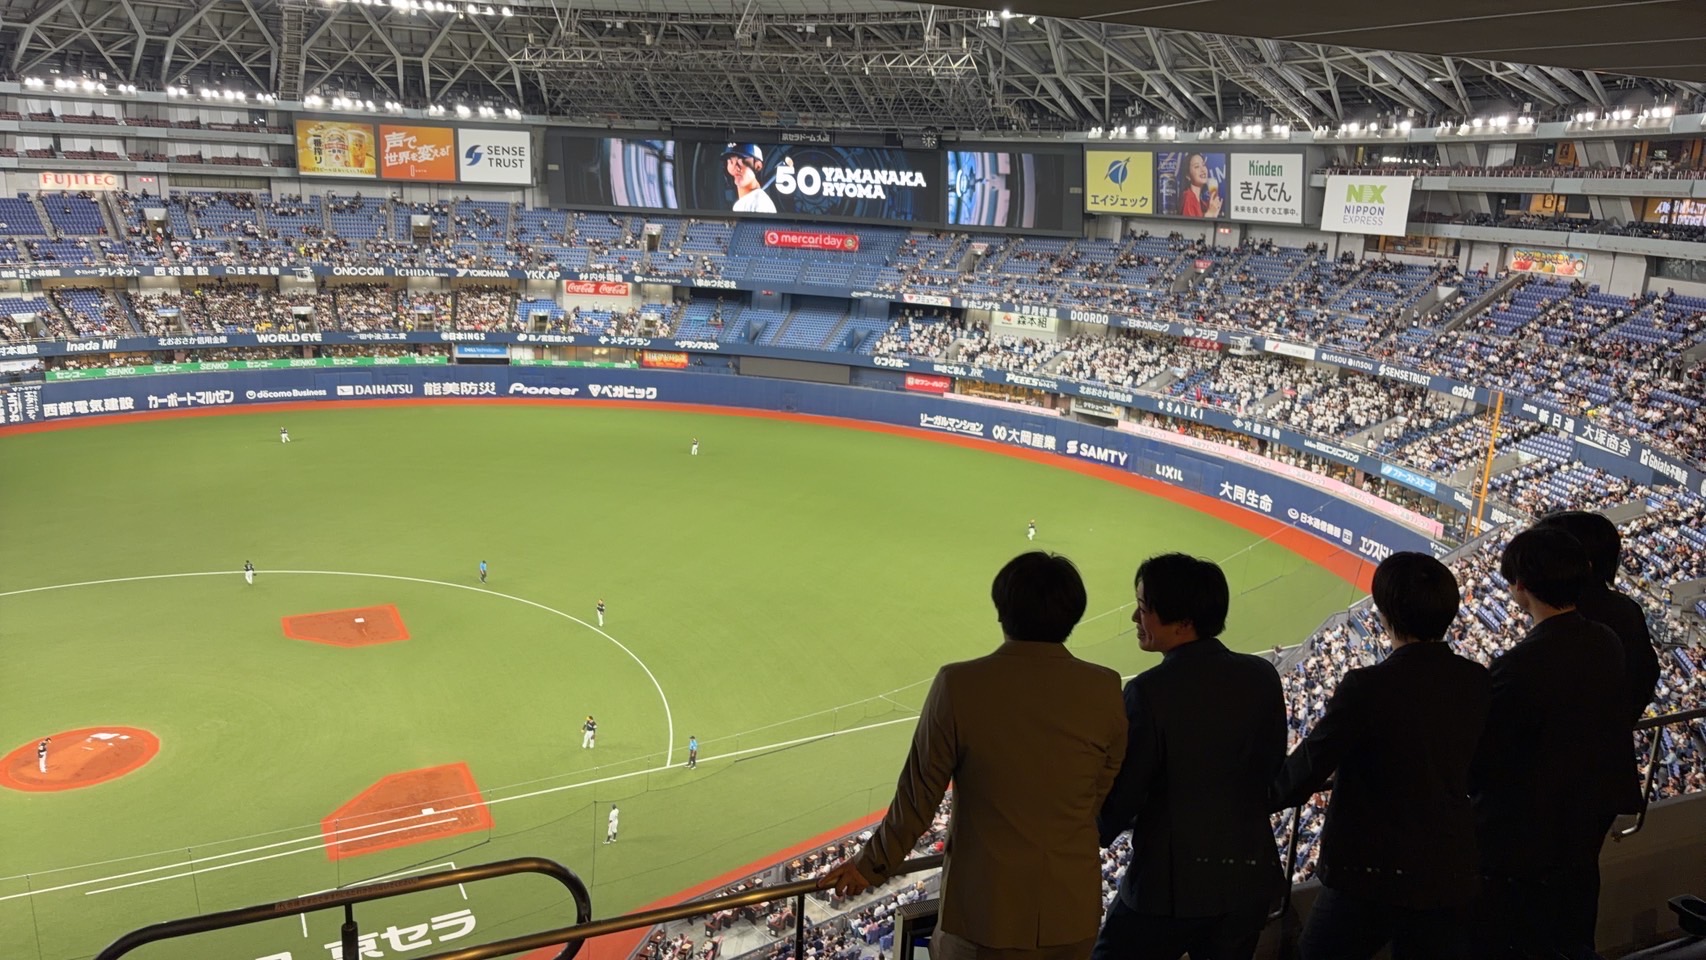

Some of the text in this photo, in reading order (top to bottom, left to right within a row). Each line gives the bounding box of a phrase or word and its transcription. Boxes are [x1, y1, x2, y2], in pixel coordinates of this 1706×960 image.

[312, 134, 323, 165] 一番搾り
[384, 132, 418, 153] 声で
[487, 145, 525, 157] SENSE
[488, 157, 525, 169] TRUST
[1249, 160, 1283, 177] Kinden
[42, 173, 117, 186] FUJITEC
[775, 166, 927, 196] 50 YAMANAKA
[822, 183, 886, 200] RYOMA
[1240, 182, 1292, 203] きんでん
[1090, 194, 1149, 209] エイジェック
[1233, 206, 1299, 217] 未来を良くする工事中。
[1344, 206, 1385, 216] NIPPON
[1342, 215, 1384, 226] EXPRESS
[780, 234, 843, 249] mercari day
[98, 267, 141, 277] テレネット
[154, 266, 209, 276] 西松建設
[332, 267, 384, 276] ONOCOM
[394, 268, 434, 277] ICHIDAI
[468, 269, 509, 278] YOKOHAMA
[524, 270, 560, 280] YKK AP
[567, 281, 628, 295] Coca-Cola Coca-Cola
[1017, 315, 1047, 328] 森本組
[1070, 310, 1109, 324] DOORDO
[1128, 318, 1170, 333] 日本カルミック
[158, 336, 228, 346] 北おおさか信用金庫
[256, 333, 322, 343] WORLD EYE
[1195, 328, 1218, 340] フジタ
[66, 340, 117, 351] Inada Mi
[55, 370, 86, 380] センコー
[105, 367, 136, 376] SENKO
[153, 364, 182, 373] センコー
[200, 362, 229, 370] SENKO
[246, 360, 274, 368] センコー
[290, 359, 317, 367] SENKO
[374, 357, 400, 365] SENKO
[257, 388, 327, 399] docomo Business
[355, 384, 414, 396] DAIHATSU
[423, 381, 497, 396] 能美防災
[508, 382, 580, 396] Pioneer
[1079, 385, 1133, 403] 北おおさか信用金庫
[1452, 385, 1475, 400] azbil
[147, 390, 235, 409] カーポートマルゼン
[43, 397, 135, 418] 西部電気建設
[1166, 404, 1204, 420] SAIKI
[920, 413, 984, 432] リーガルマンション
[1582, 425, 1631, 456] 大塚商会
[1079, 443, 1128, 466] SAMTY
[1155, 463, 1184, 482] LIXIL
[1219, 481, 1274, 513] 大同生命
